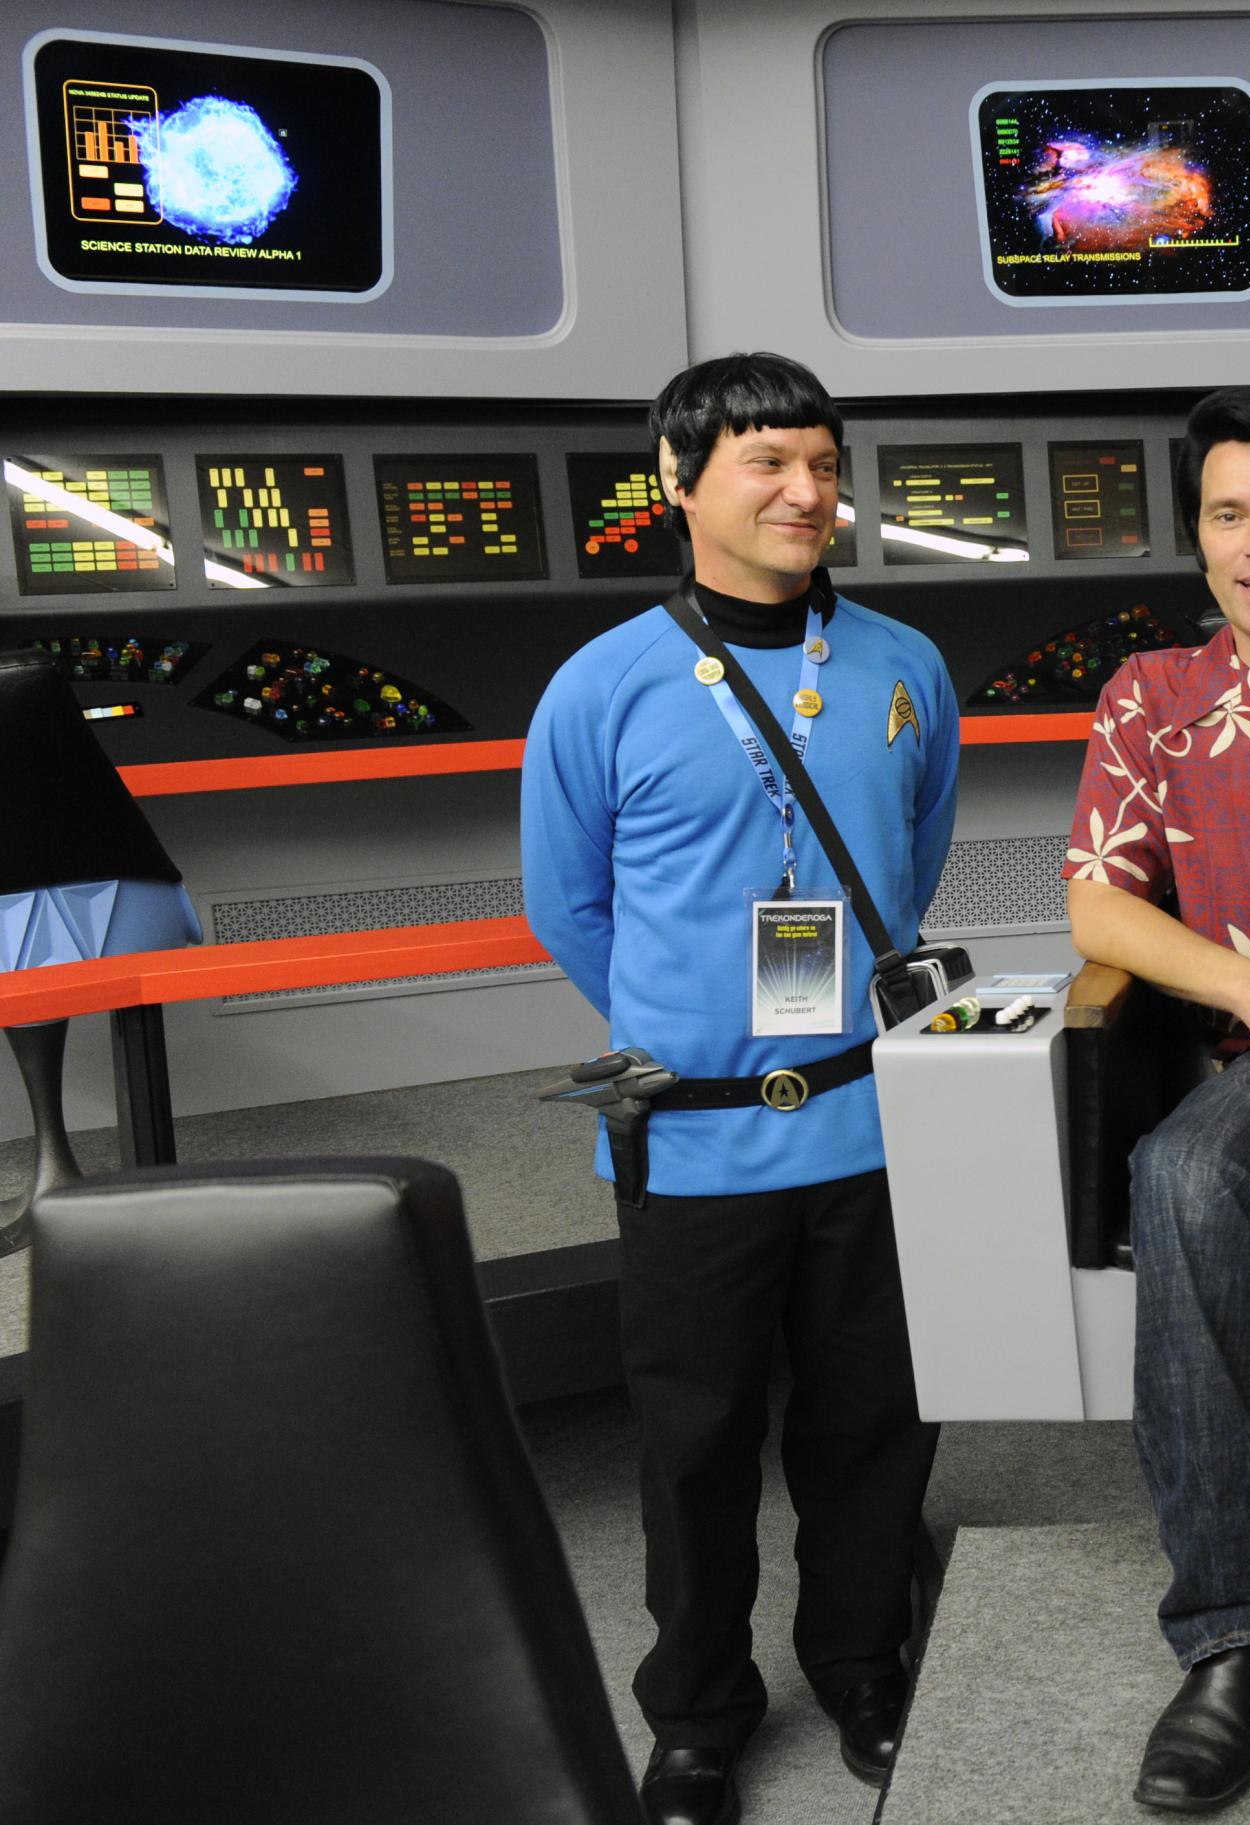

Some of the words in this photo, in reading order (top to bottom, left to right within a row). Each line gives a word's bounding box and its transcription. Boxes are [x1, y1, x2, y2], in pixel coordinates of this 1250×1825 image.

[81, 240, 132, 252] SCIENCE
[134, 242, 182, 255] STATION
[184, 245, 212, 256] DATA
[214, 246, 257, 258] REVIEW
[258, 249, 294, 260] ALPHA
[296, 251, 302, 261] 1
[997, 255, 1042, 264] SUBSPACE
[1043, 254, 1071, 263] RELAY
[1071, 252, 1141, 262] TRANSMISSIONS
[741, 737, 768, 767] STAR
[759, 768, 781, 798] TREK
[760, 914, 832, 922] TREKONDEROGA
[774, 1007, 816, 1015] SCHUBERT
